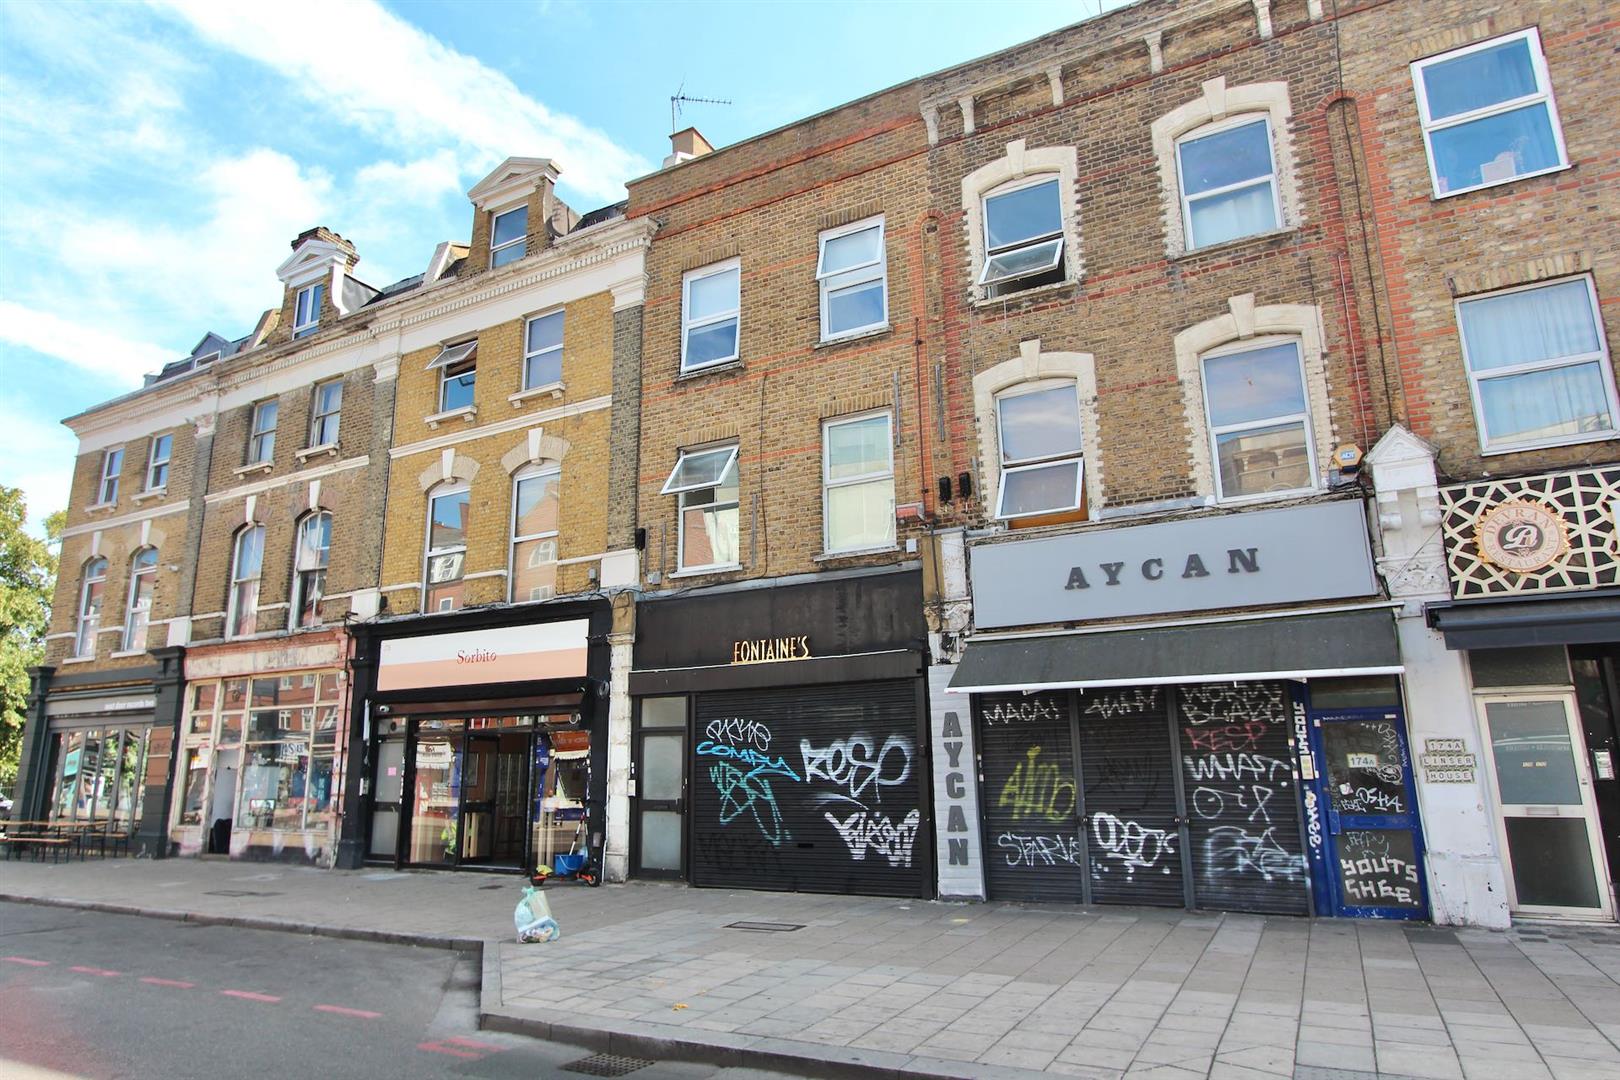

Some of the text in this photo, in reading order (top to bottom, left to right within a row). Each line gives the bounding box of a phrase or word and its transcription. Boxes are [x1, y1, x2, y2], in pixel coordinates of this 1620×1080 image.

[1485, 508, 1553, 535] DEVRAN
[1064, 548, 1260, 590] AYCAN
[456, 648, 497, 664] Sorbito
[734, 635, 809, 663] FONTAINE'S
[1423, 757, 1472, 765] LINSER
[942, 711, 968, 866] AYCAN
